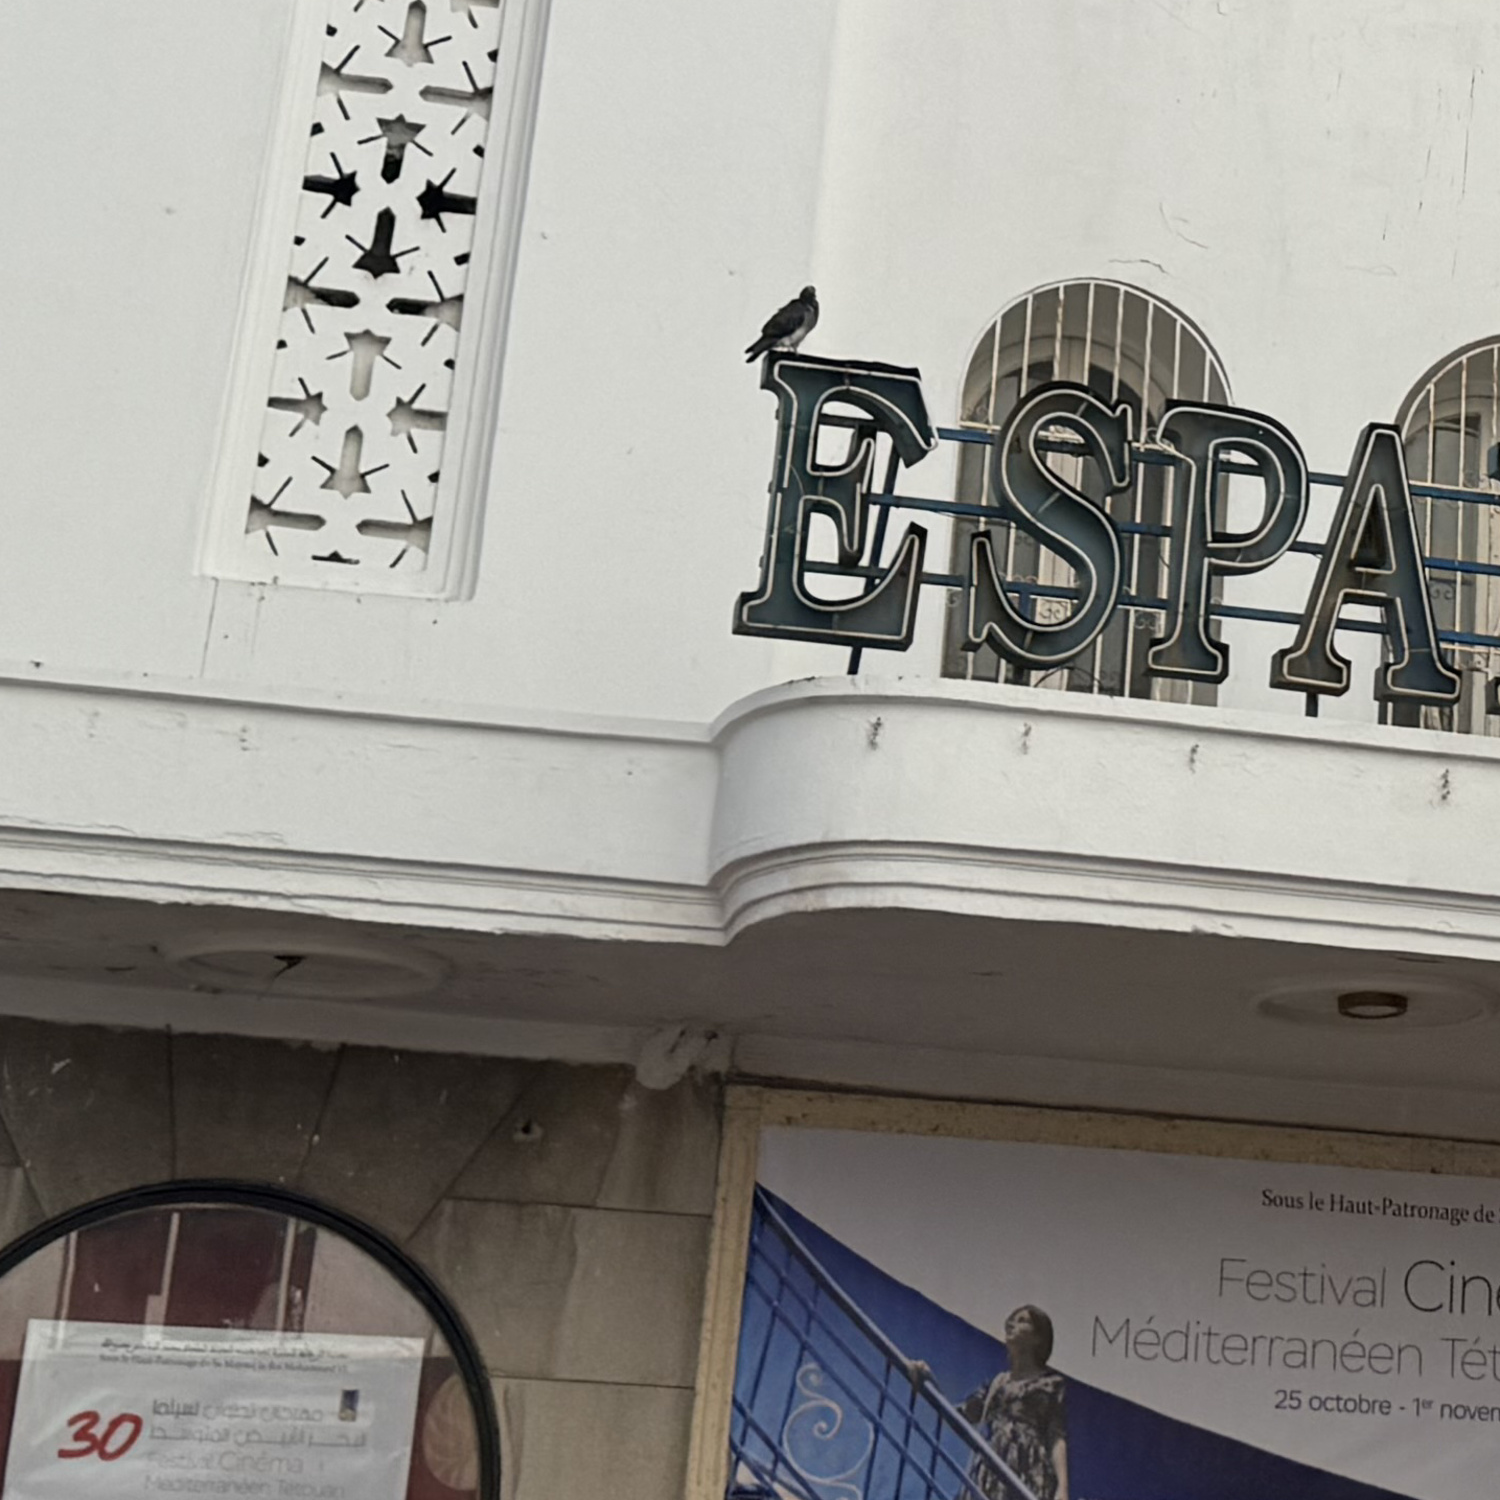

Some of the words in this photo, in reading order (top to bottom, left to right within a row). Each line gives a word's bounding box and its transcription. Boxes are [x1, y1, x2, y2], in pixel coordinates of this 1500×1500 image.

[1262, 1188, 1304, 1210] Sous
[1309, 1191, 1326, 1211] le
[1330, 1193, 1470, 1227] Haut-Patronage
[1473, 1204, 1496, 1224] de
[1218, 1257, 1387, 1309] Festival
[1091, 1314, 1423, 1378] Méditerranéen
[1273, 1388, 1303, 1412] 25
[1308, 1392, 1393, 1418] octobre
[1411, 1396, 1435, 1419] 1er
[58, 1410, 143, 1461] 30
